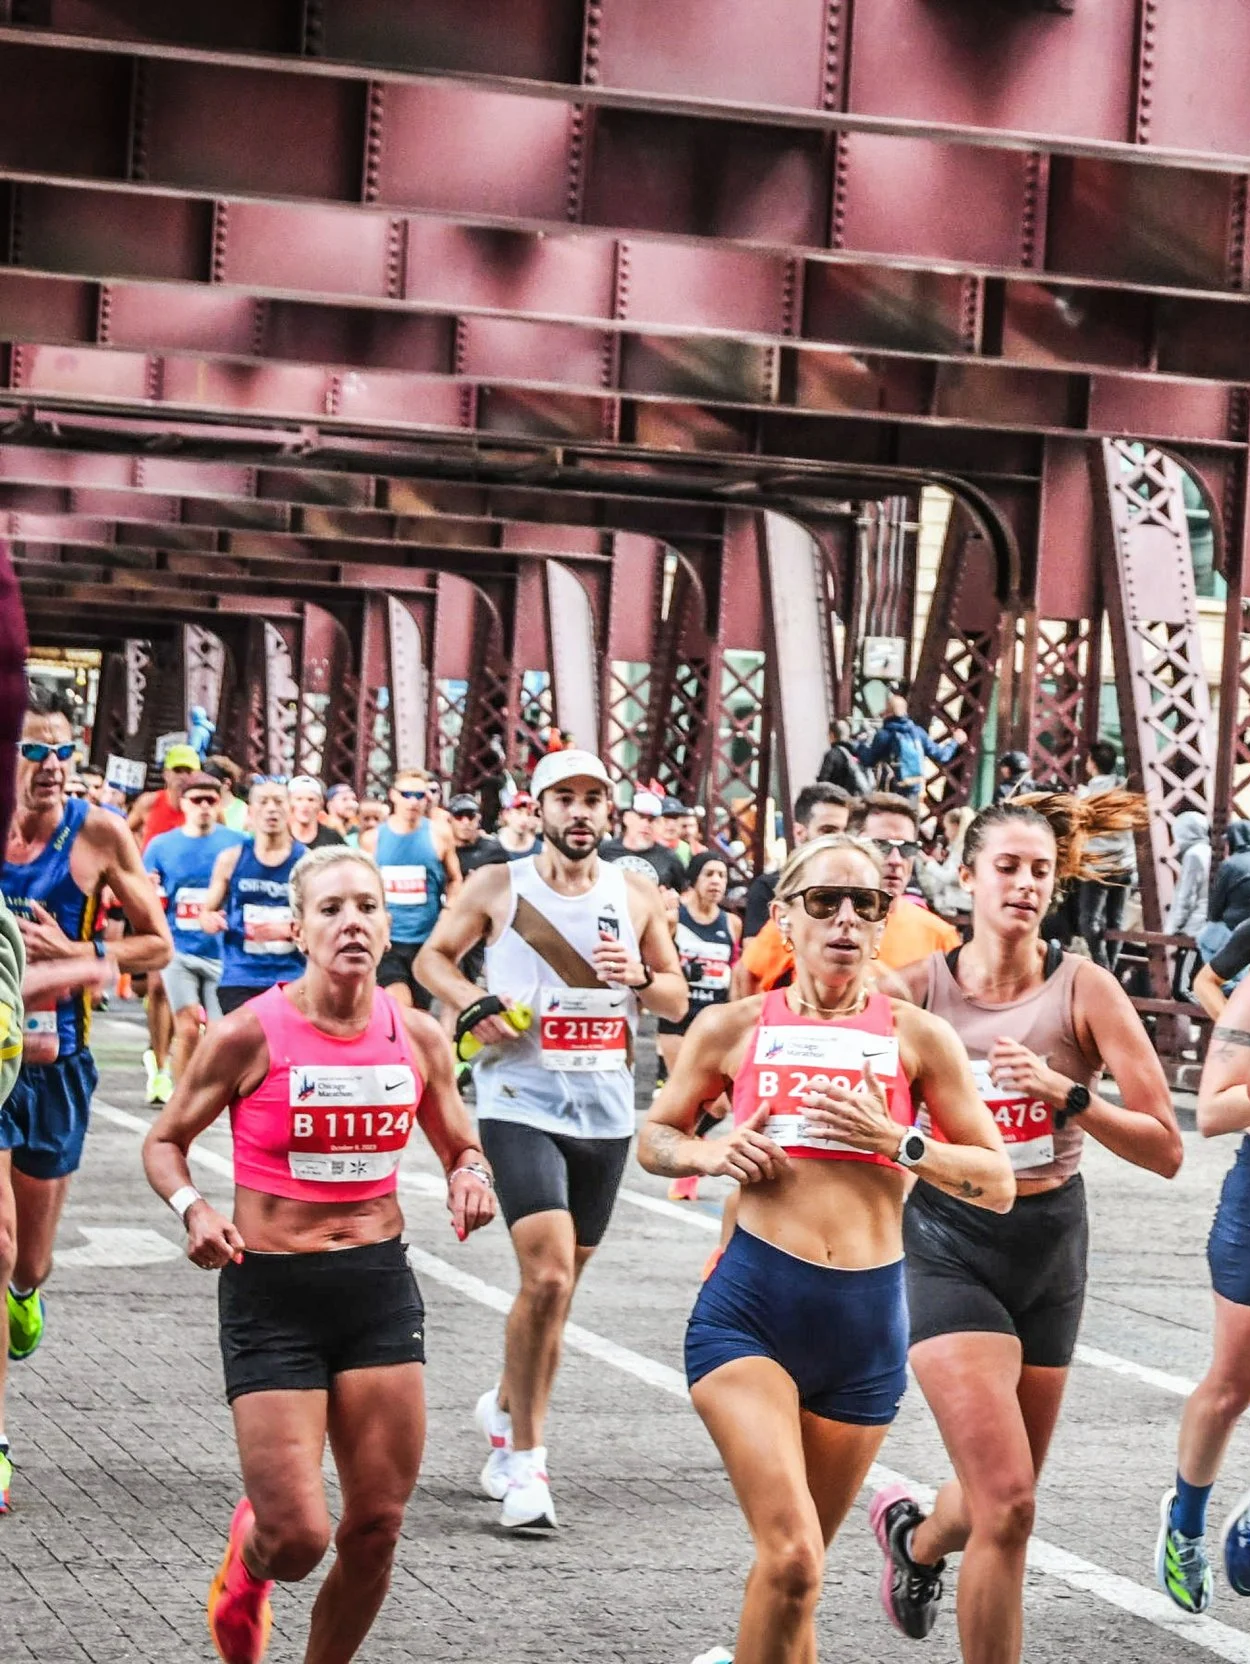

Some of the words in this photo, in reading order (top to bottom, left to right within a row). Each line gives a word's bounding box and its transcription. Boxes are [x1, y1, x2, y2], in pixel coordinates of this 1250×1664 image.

[544, 1021, 559, 1039] C
[564, 1020, 624, 1040] 21527
[318, 1083, 346, 1093] Chicago
[318, 1090, 354, 1098] Marathon
[758, 1071, 779, 1097] B
[294, 1113, 314, 1137] B
[325, 1111, 410, 1138] 11124
